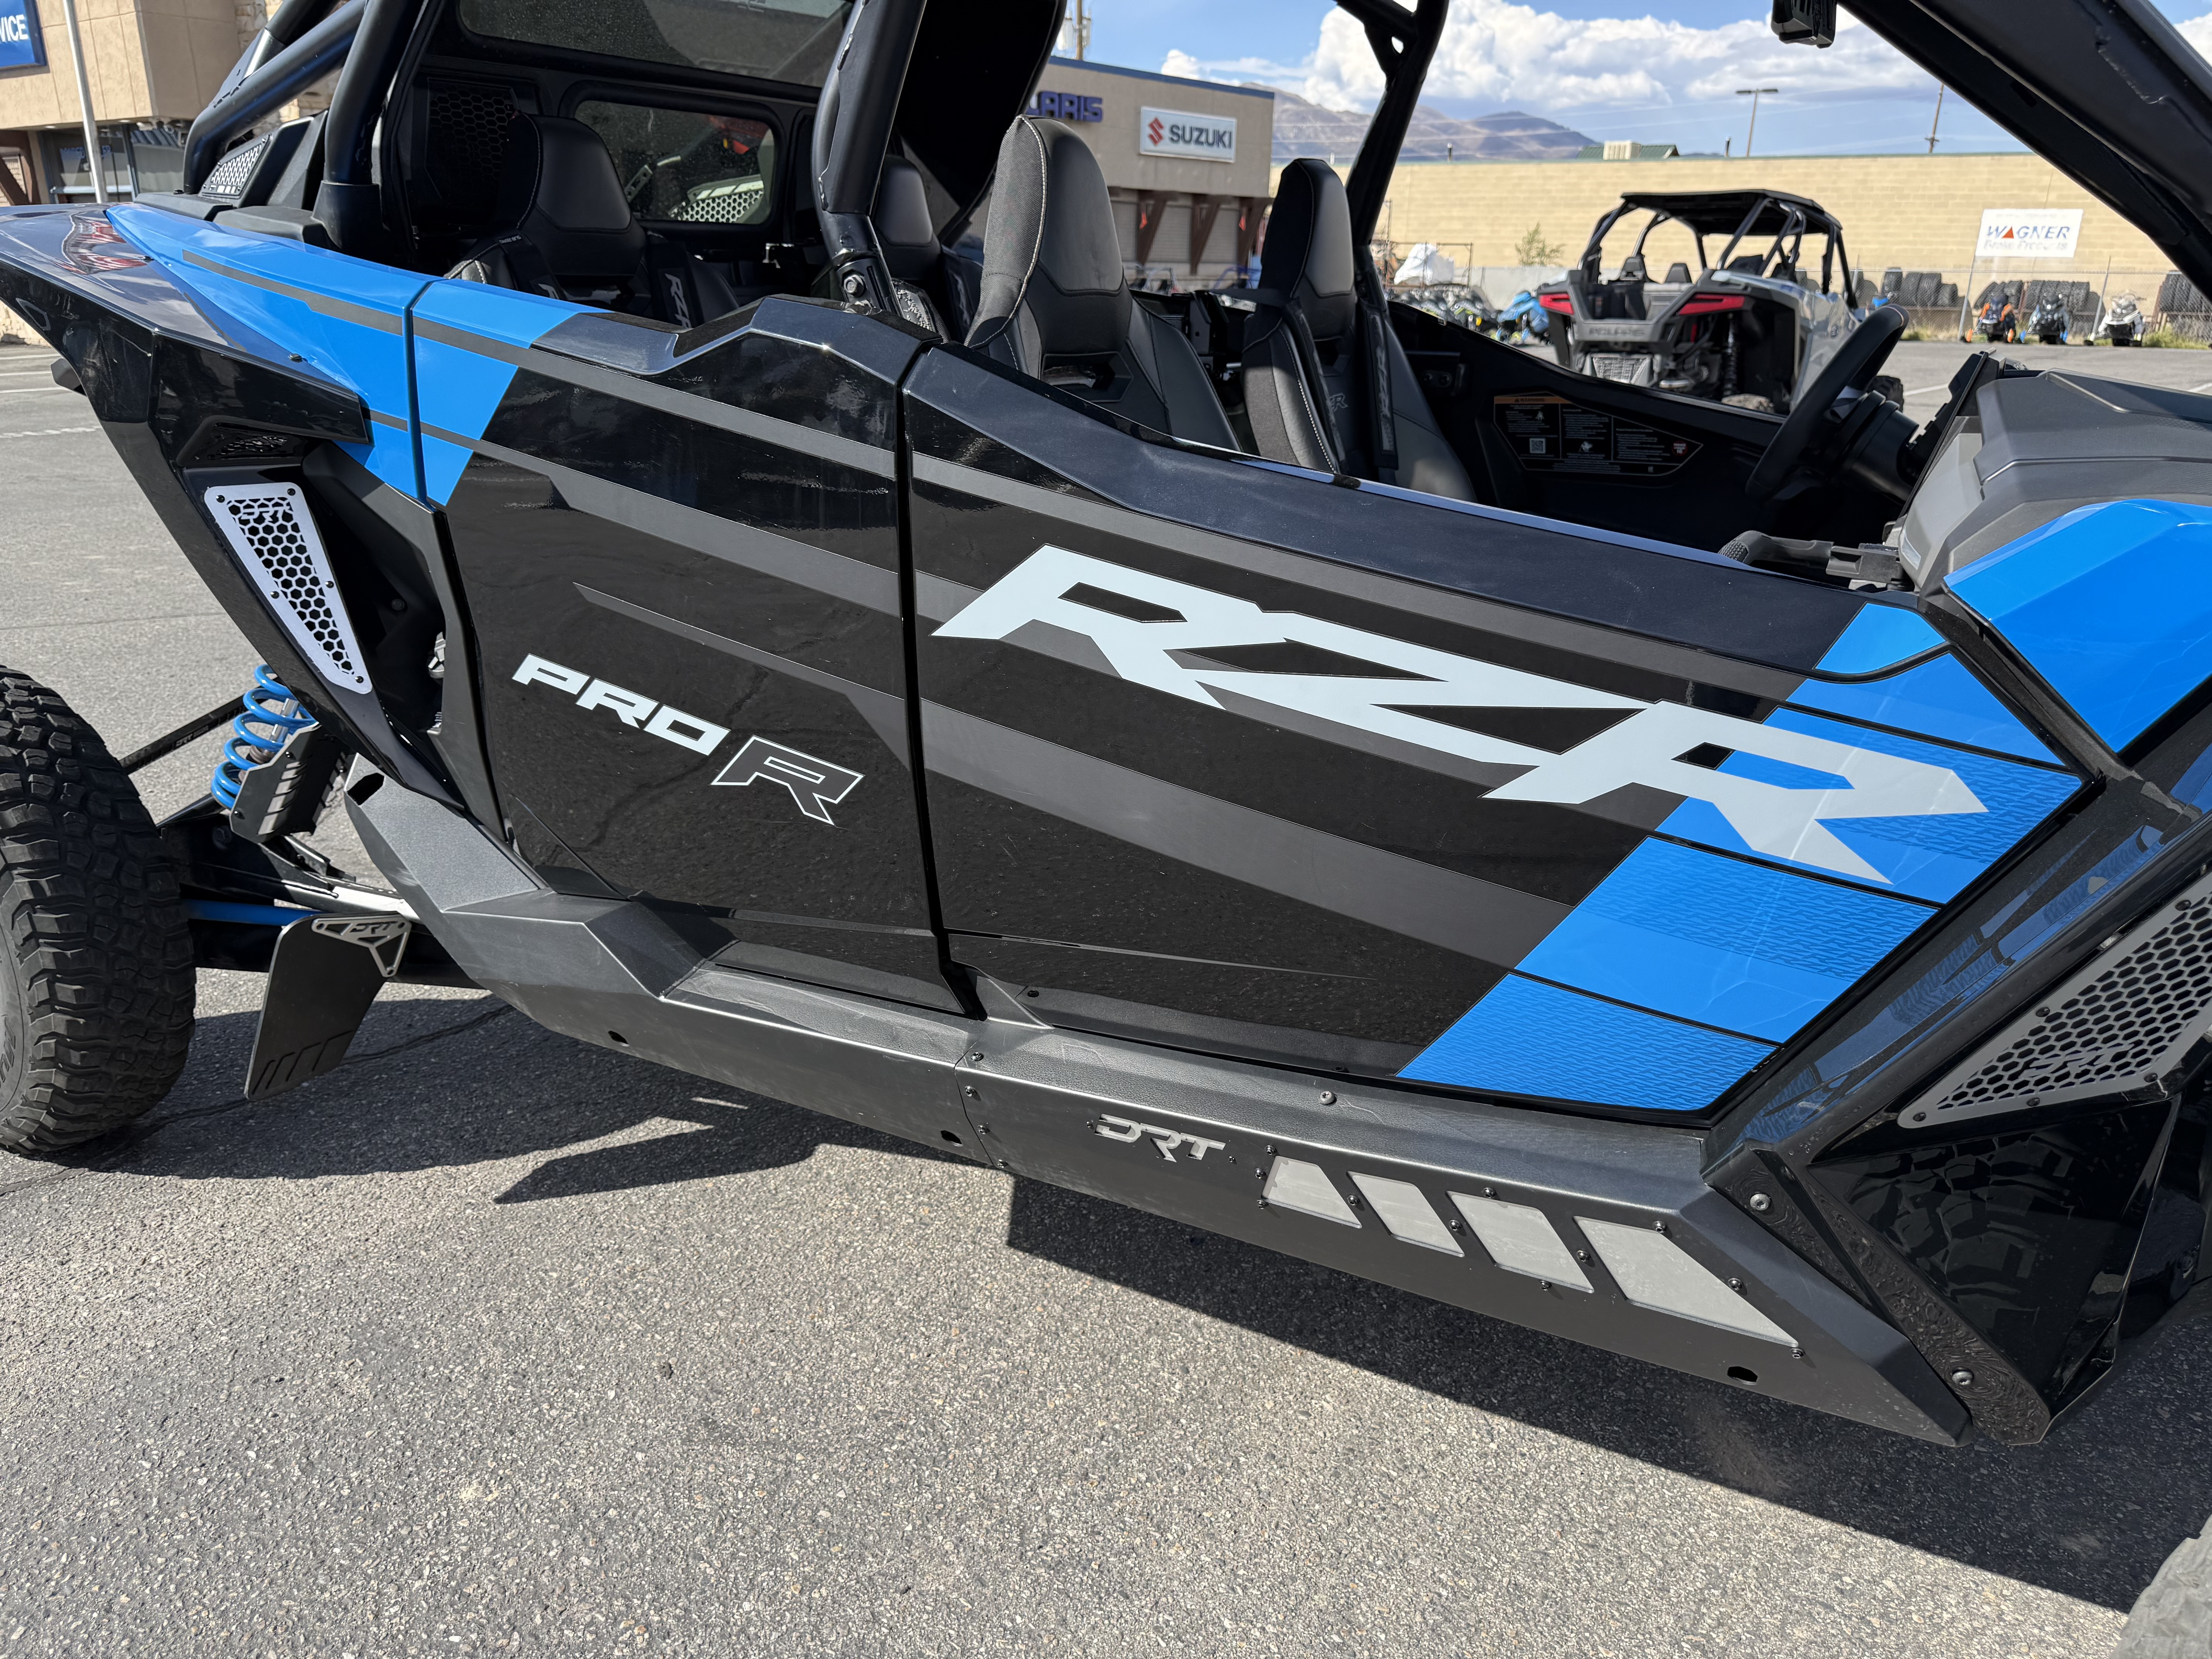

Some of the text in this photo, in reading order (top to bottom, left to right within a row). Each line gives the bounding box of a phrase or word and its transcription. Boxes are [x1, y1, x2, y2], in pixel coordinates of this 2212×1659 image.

[1169, 124, 1232, 149] SUZUKI
[512, 653, 865, 826] PRO R
[931, 544, 1989, 883] RZR
[1094, 1113, 1226, 1163] DRT
